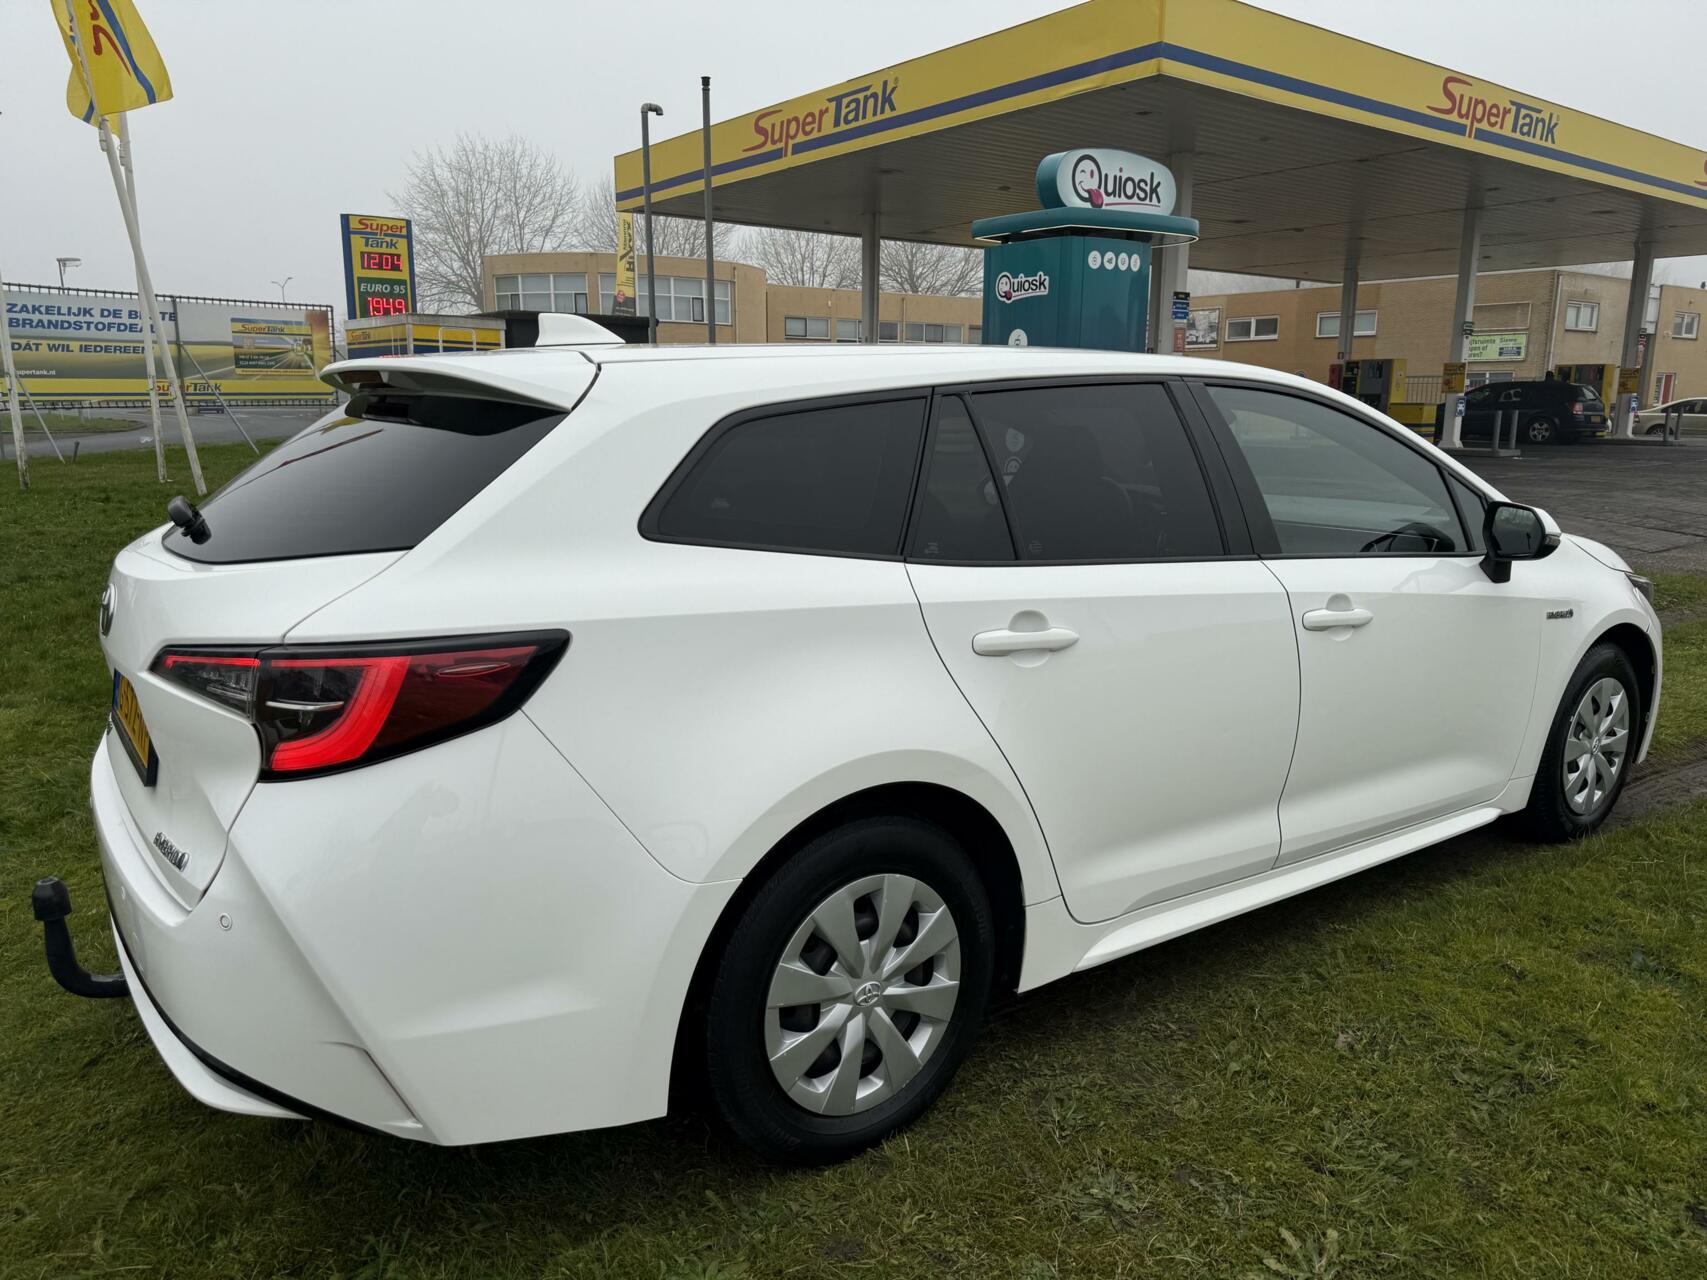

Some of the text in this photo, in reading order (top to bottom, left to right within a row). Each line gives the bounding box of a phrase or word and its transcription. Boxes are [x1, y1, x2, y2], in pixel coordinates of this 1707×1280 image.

[1072, 153, 1161, 208] Quiosk
[352, 218, 406, 236] Super
[360, 237, 399, 250] Tank
[360, 283, 406, 294] EURO 95
[997, 274, 1047, 300] Quiosk
[6, 302, 177, 321] ZAKELIJK DE BTE
[47, 343, 74, 353] WIL
